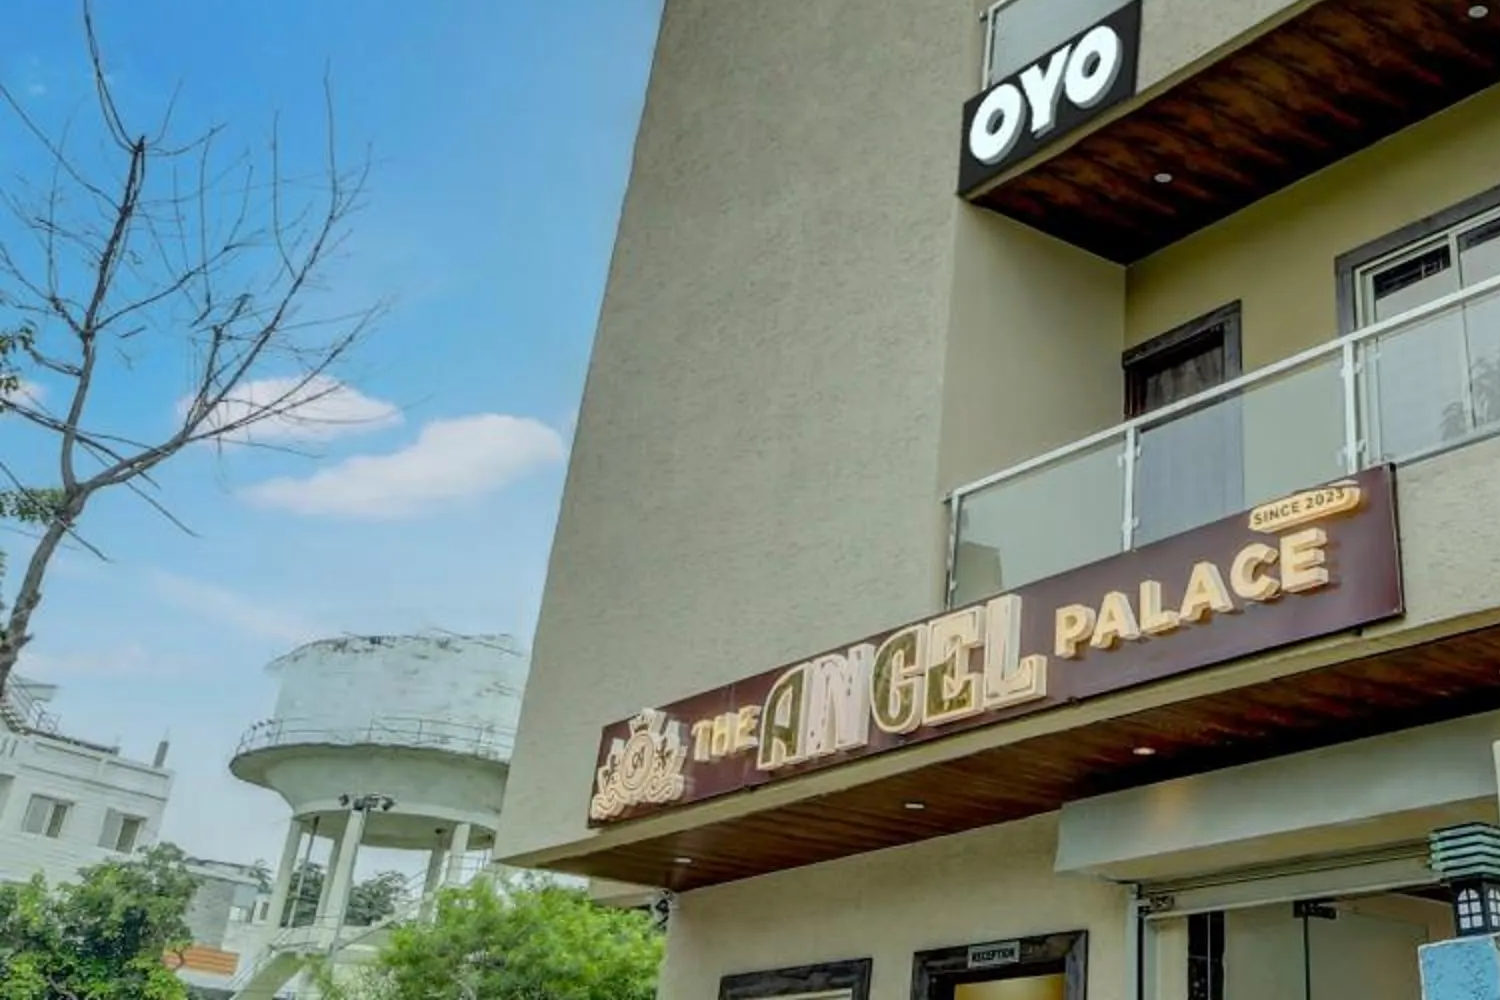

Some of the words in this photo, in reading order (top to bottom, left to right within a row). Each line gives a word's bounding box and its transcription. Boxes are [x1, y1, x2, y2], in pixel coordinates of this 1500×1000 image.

[969, 25, 1123, 165] OYO
[1253, 501, 1301, 525] SINCE
[1305, 488, 1345, 510] 2023
[691, 705, 761, 762] THE
[757, 593, 1048, 771] ANGEL
[1054, 527, 1330, 660] PALACE
